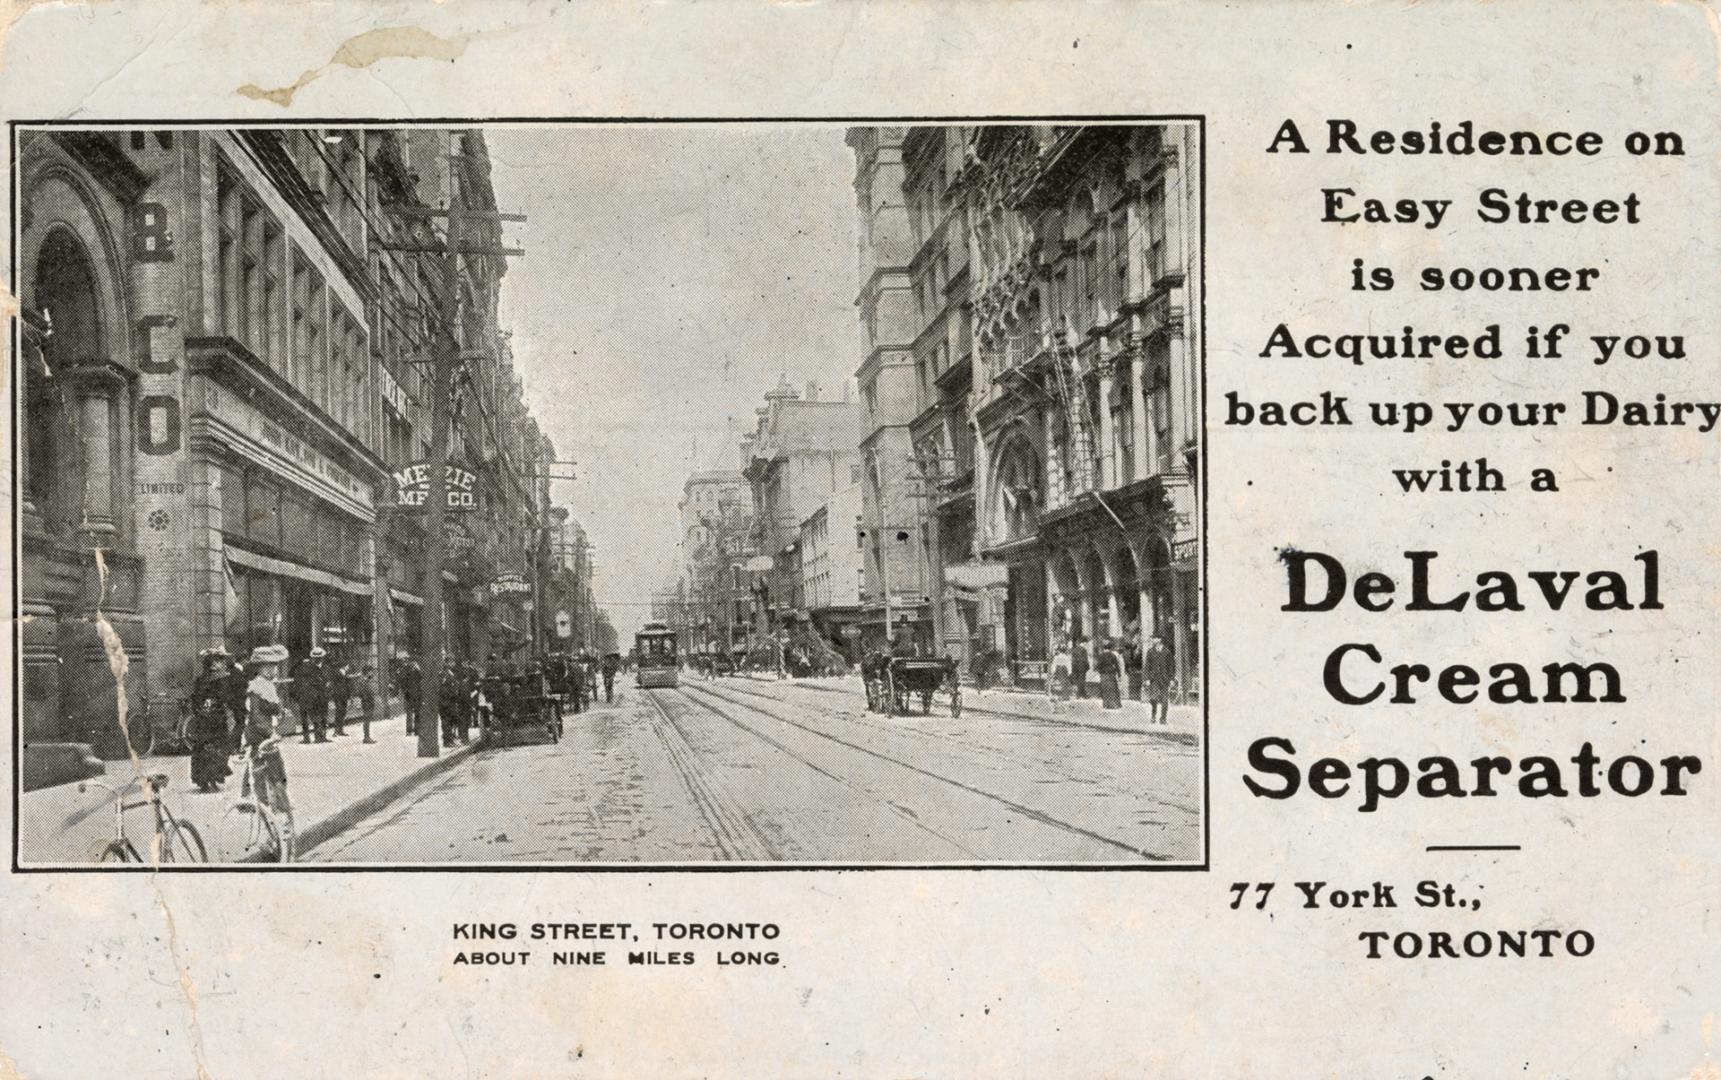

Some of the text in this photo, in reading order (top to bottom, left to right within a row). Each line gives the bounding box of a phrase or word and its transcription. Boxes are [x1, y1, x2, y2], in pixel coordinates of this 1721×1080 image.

[1266, 119, 1685, 155] A Residence on
[1321, 188, 1641, 229] Easy Street
[1351, 258, 1599, 291] is sooner
[1259, 324, 1686, 365] Acquired if you
[1224, 391, 1721, 432] back up your Dairy
[141, 482, 185, 494] LIMITED
[393, 464, 477, 491] MEZIE
[1392, 458, 1559, 492] with a
[447, 491, 477, 507] CO.
[1323, 643, 1627, 705] Cream
[1243, 737, 1701, 812] Separator
[1230, 881, 1482, 910] 77 York St.,
[453, 923, 780, 941] KING STREET, TORONTO
[1358, 929, 1595, 958] TORONTO
[453, 952, 531, 965] ABOUT
[553, 952, 606, 965] NINE
[628, 952, 695, 965] MILES
